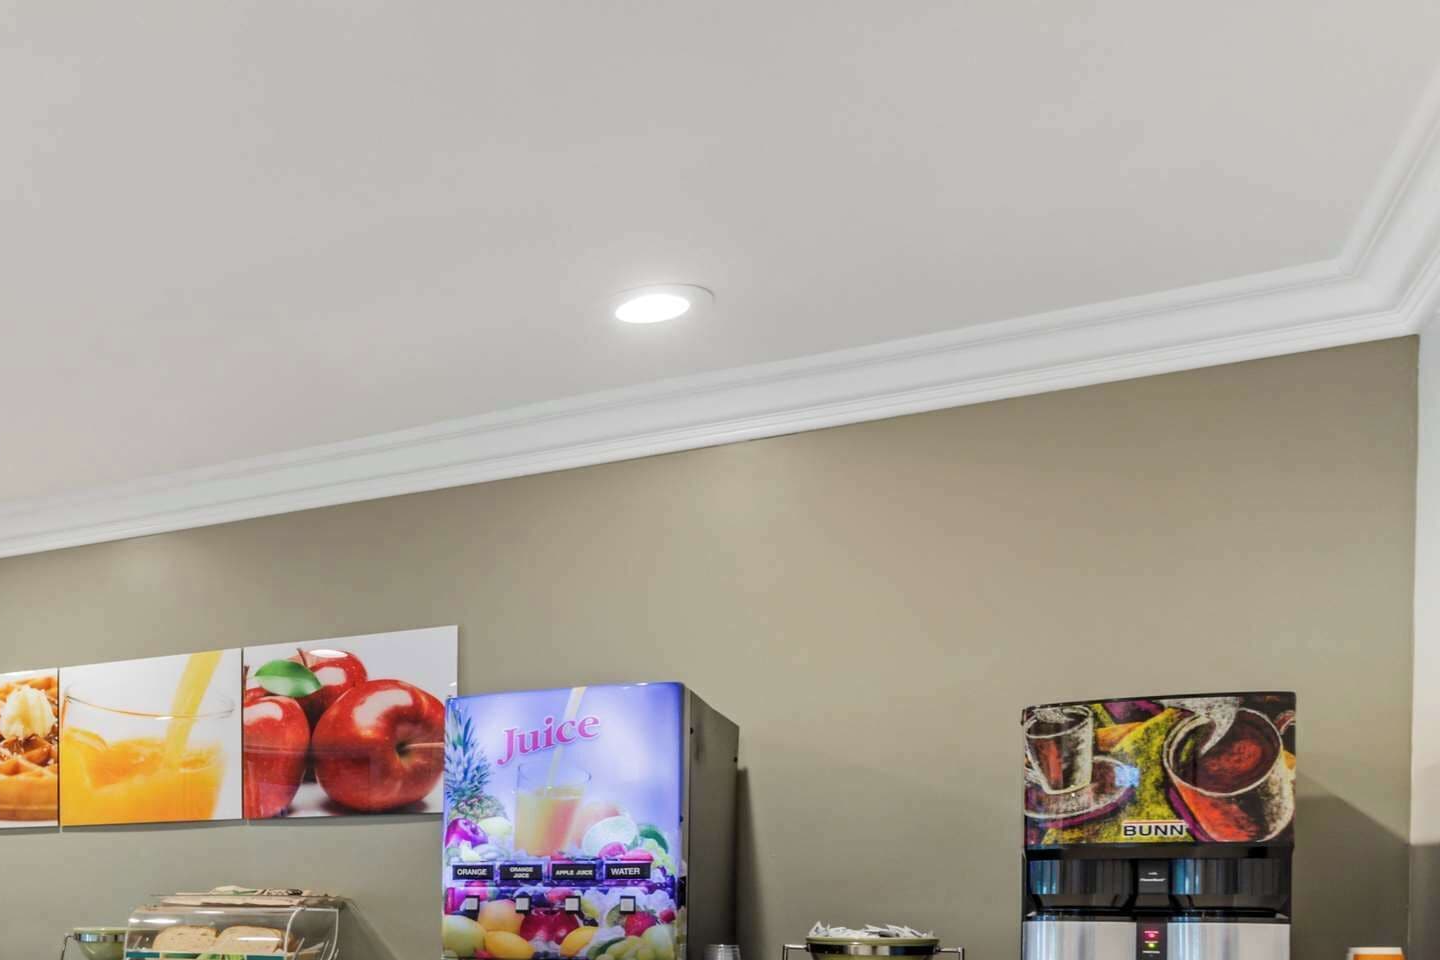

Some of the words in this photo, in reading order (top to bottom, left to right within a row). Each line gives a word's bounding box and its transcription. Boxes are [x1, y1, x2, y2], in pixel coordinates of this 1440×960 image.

[496, 716, 600, 766] Juice
[1123, 824, 1184, 837] BUNN
[457, 868, 488, 876] ORANGE
[555, 869, 575, 877] APPLE
[610, 866, 641, 877] WATER
